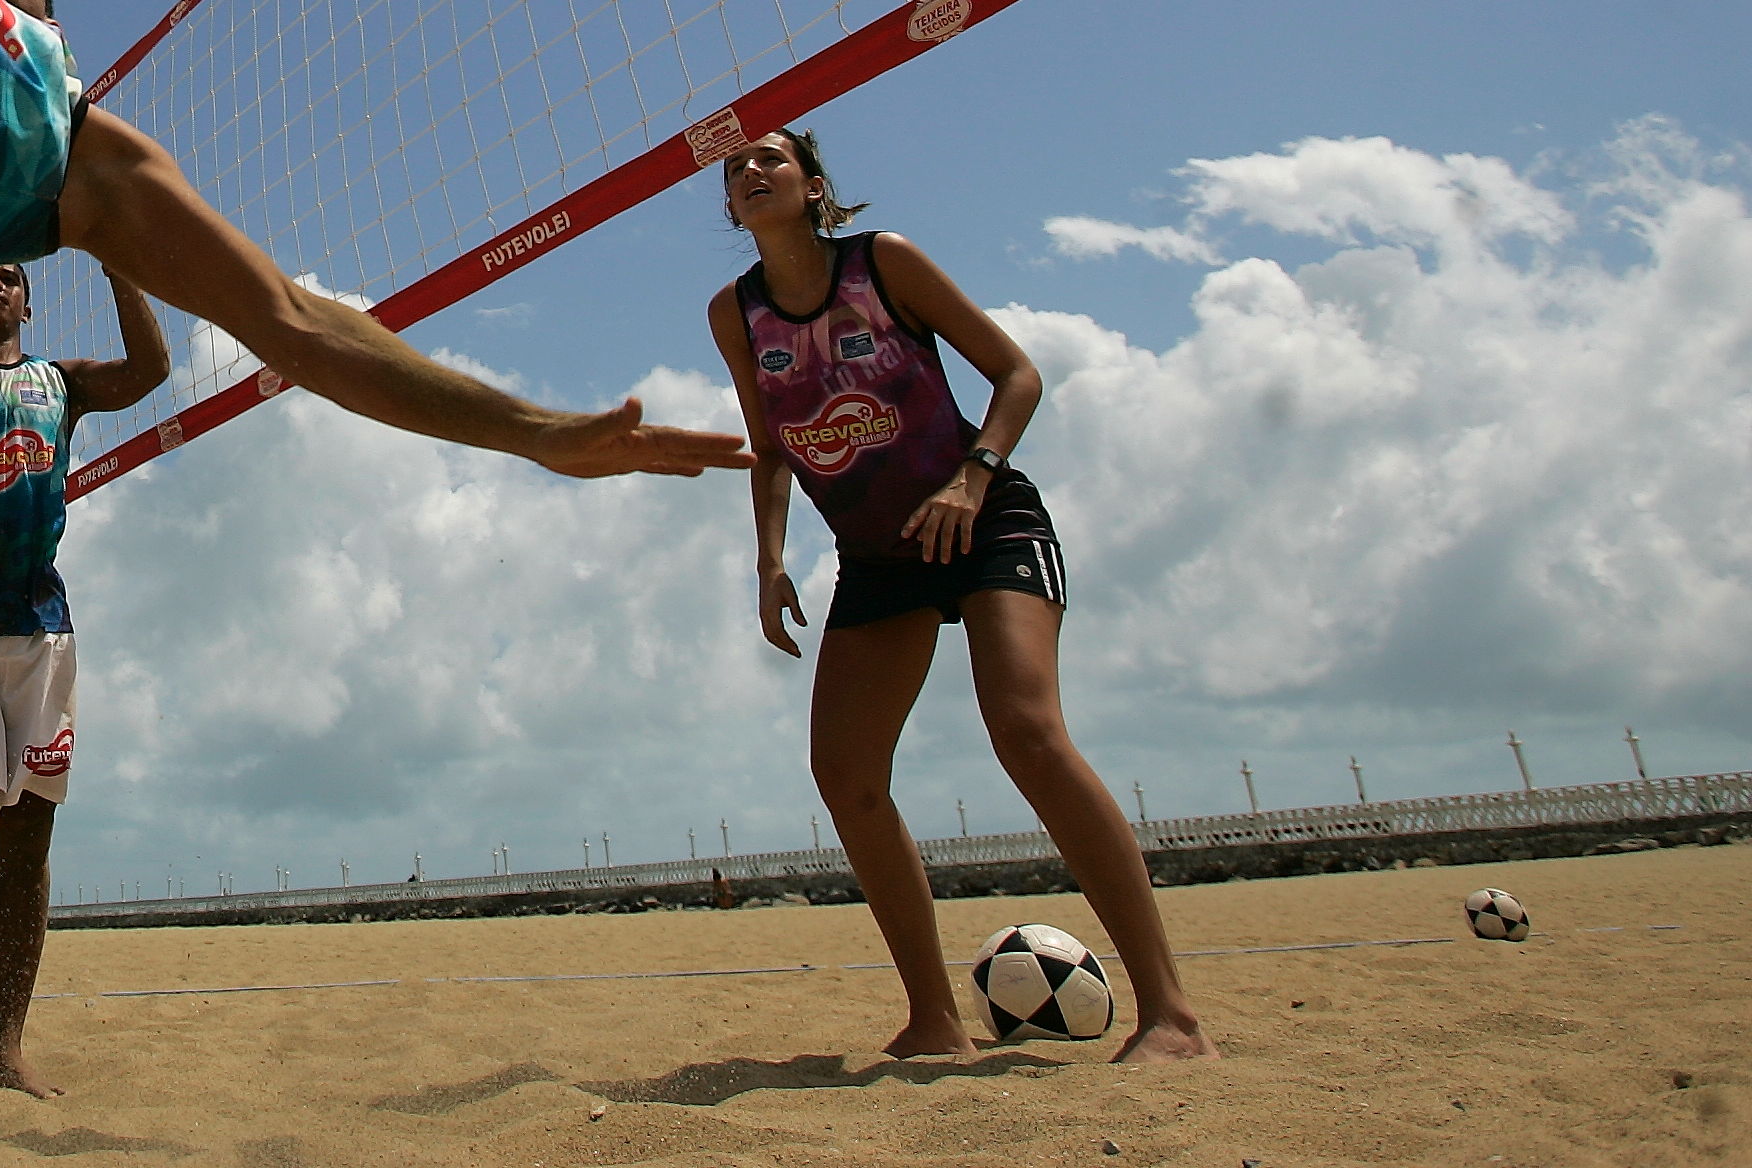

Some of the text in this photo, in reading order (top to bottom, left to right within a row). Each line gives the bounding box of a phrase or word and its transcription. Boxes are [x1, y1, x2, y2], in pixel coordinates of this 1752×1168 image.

[920, 11, 962, 37] TECIDOS
[481, 210, 571, 272] FUTEVOLEI
[784, 410, 897, 447] futevolei
